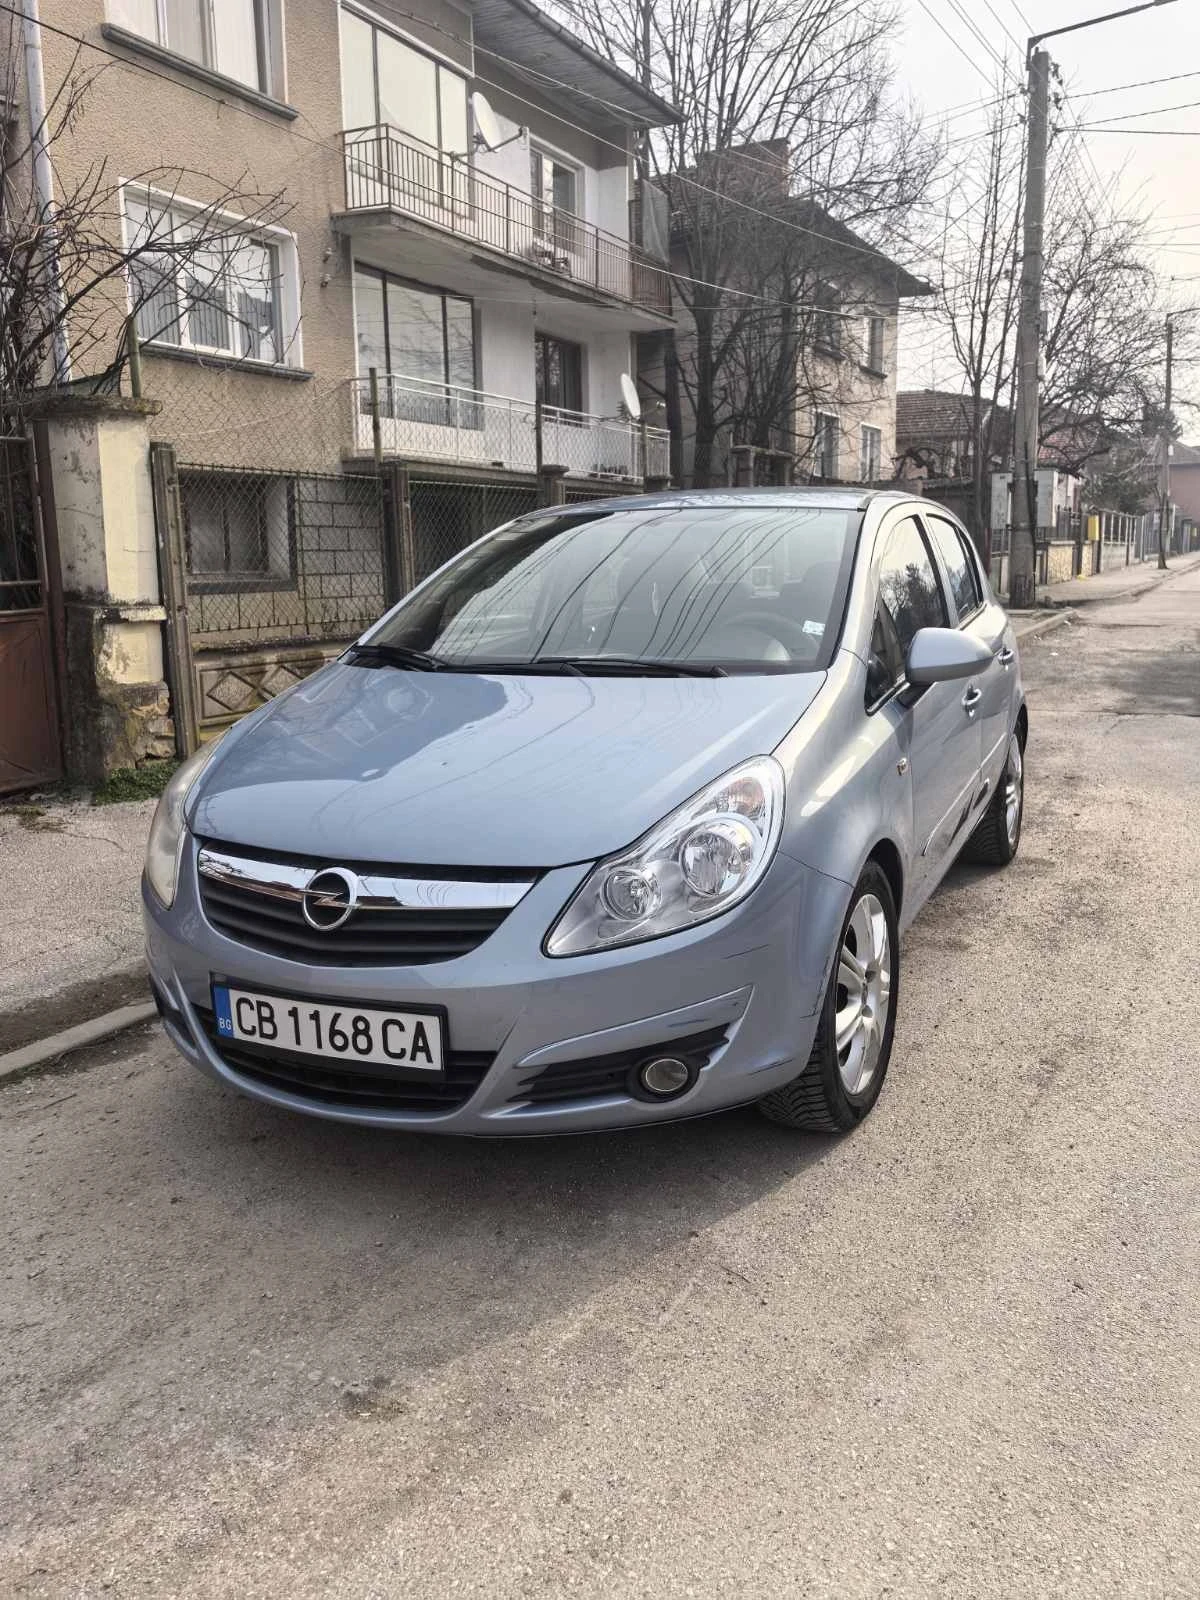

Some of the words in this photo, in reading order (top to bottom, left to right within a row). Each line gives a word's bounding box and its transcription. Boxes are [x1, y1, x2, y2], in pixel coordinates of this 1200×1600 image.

[218, 1017, 232, 1031] BG
[235, 997, 278, 1040] CB
[287, 1006, 374, 1055] 1168
[381, 1018, 434, 1064] CA
